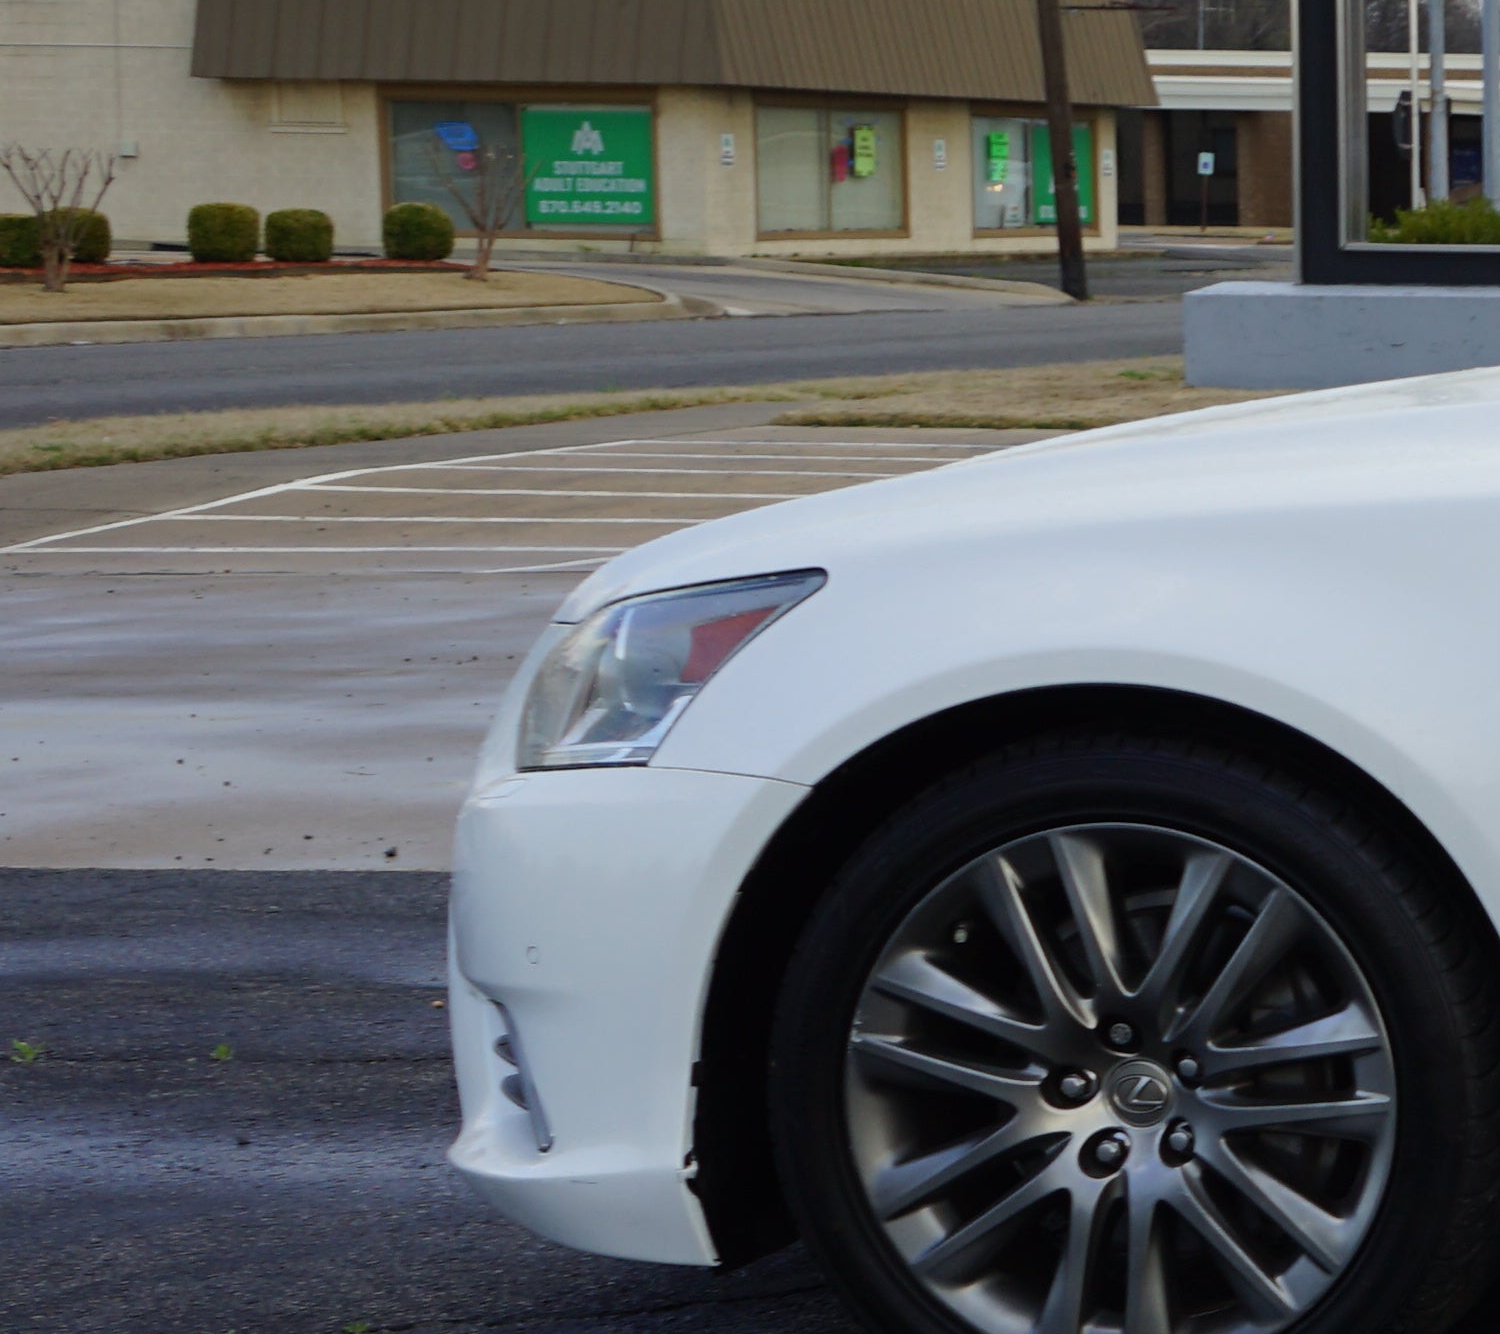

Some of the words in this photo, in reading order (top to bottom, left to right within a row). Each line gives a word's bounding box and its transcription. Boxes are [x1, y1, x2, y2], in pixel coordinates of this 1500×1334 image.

[553, 160, 623, 175] STUTTGART
[533, 177, 573, 192] ADULT
[575, 177, 647, 193] EDUCATION
